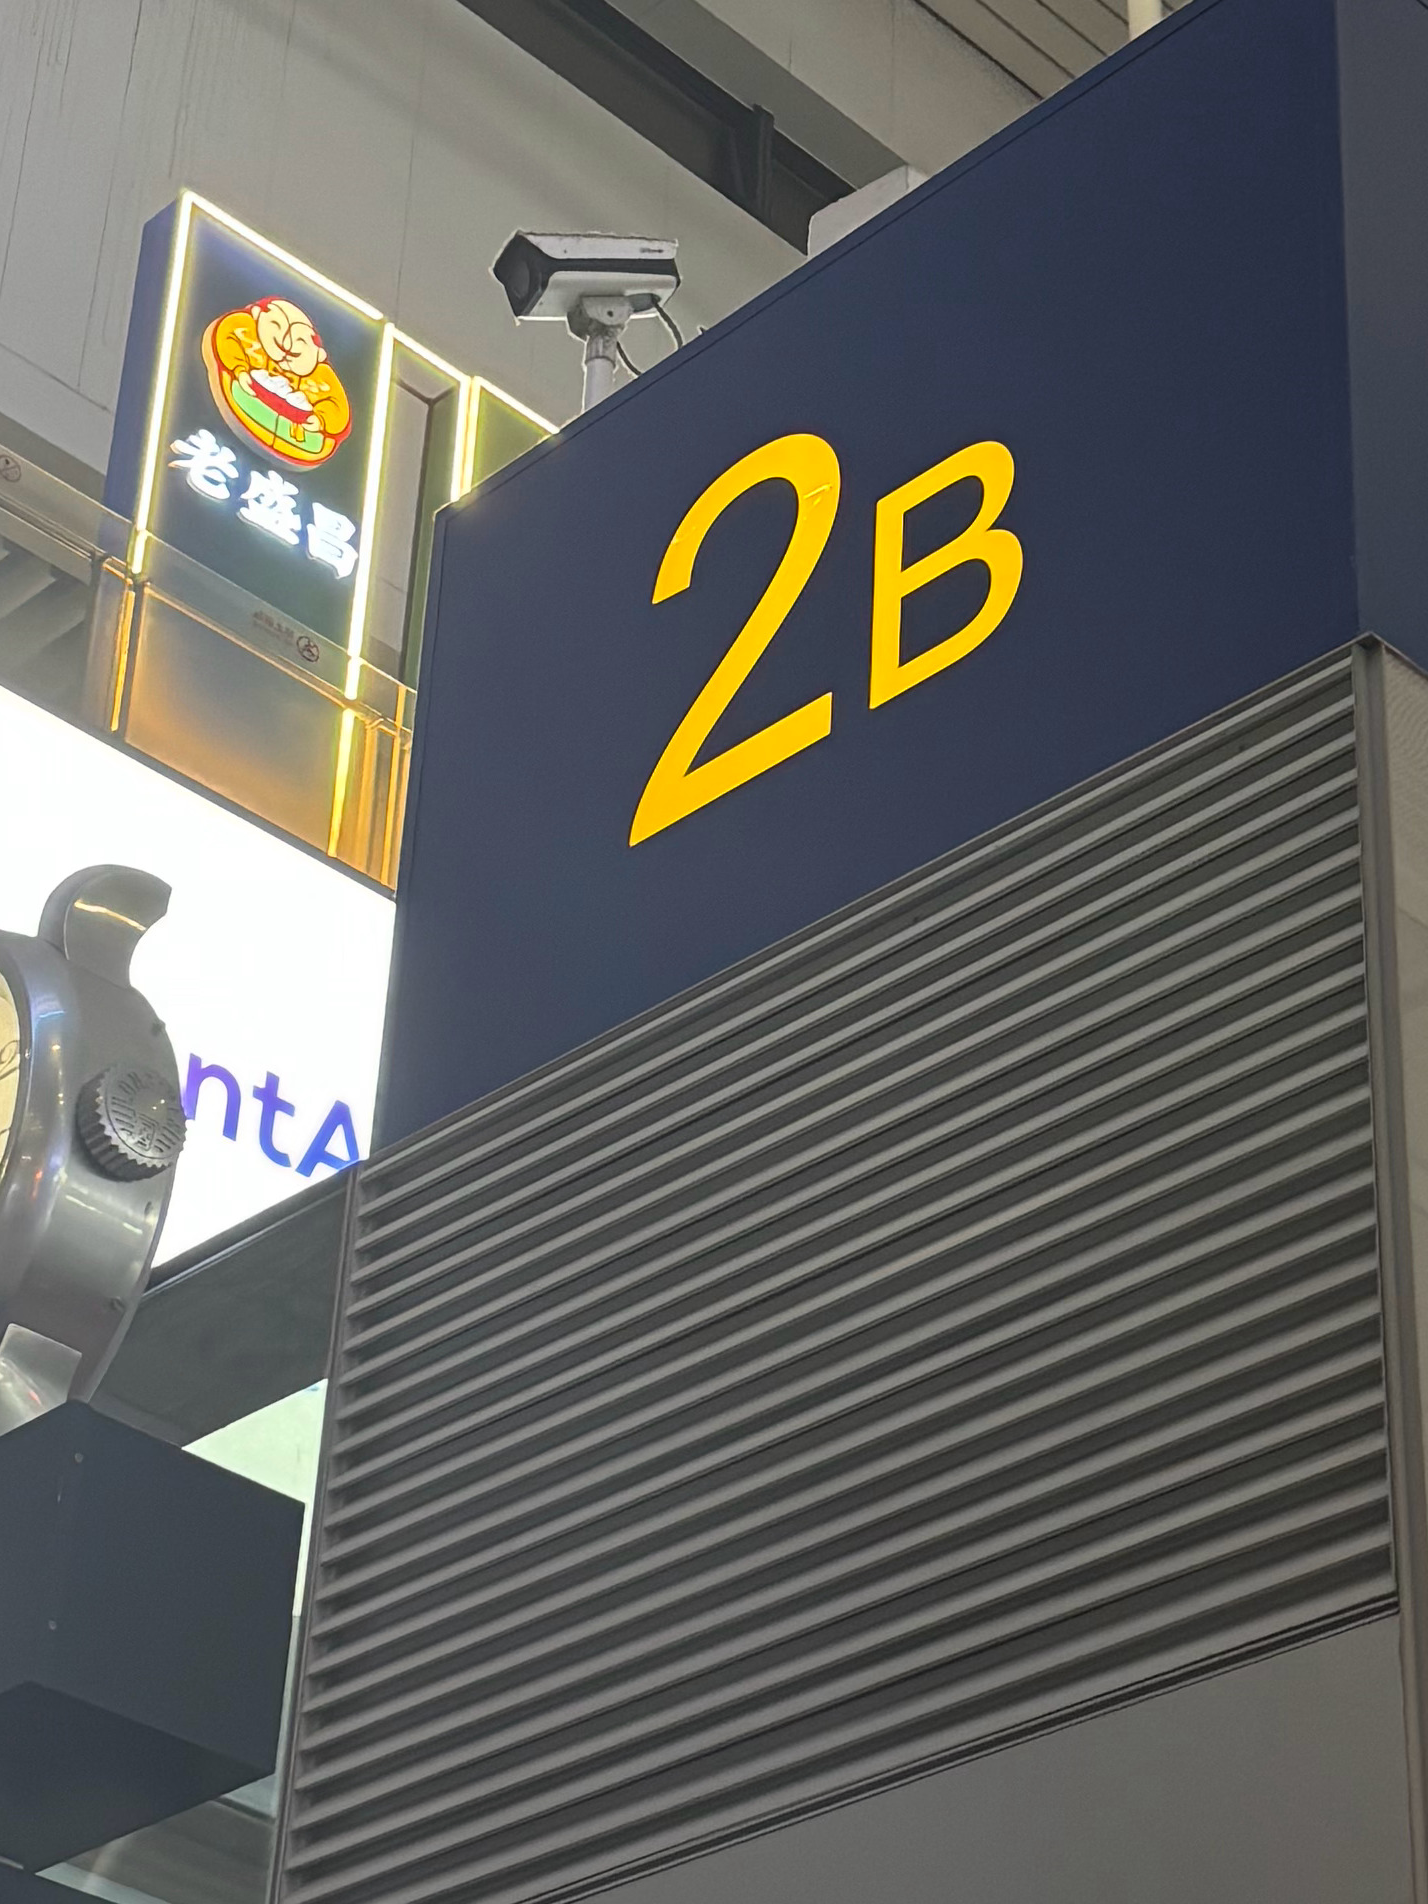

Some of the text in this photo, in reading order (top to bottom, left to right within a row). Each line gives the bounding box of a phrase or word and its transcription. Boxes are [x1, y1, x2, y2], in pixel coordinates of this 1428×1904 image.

[169, 428, 359, 579] 老盛昌
[629, 433, 1024, 846] 2B
